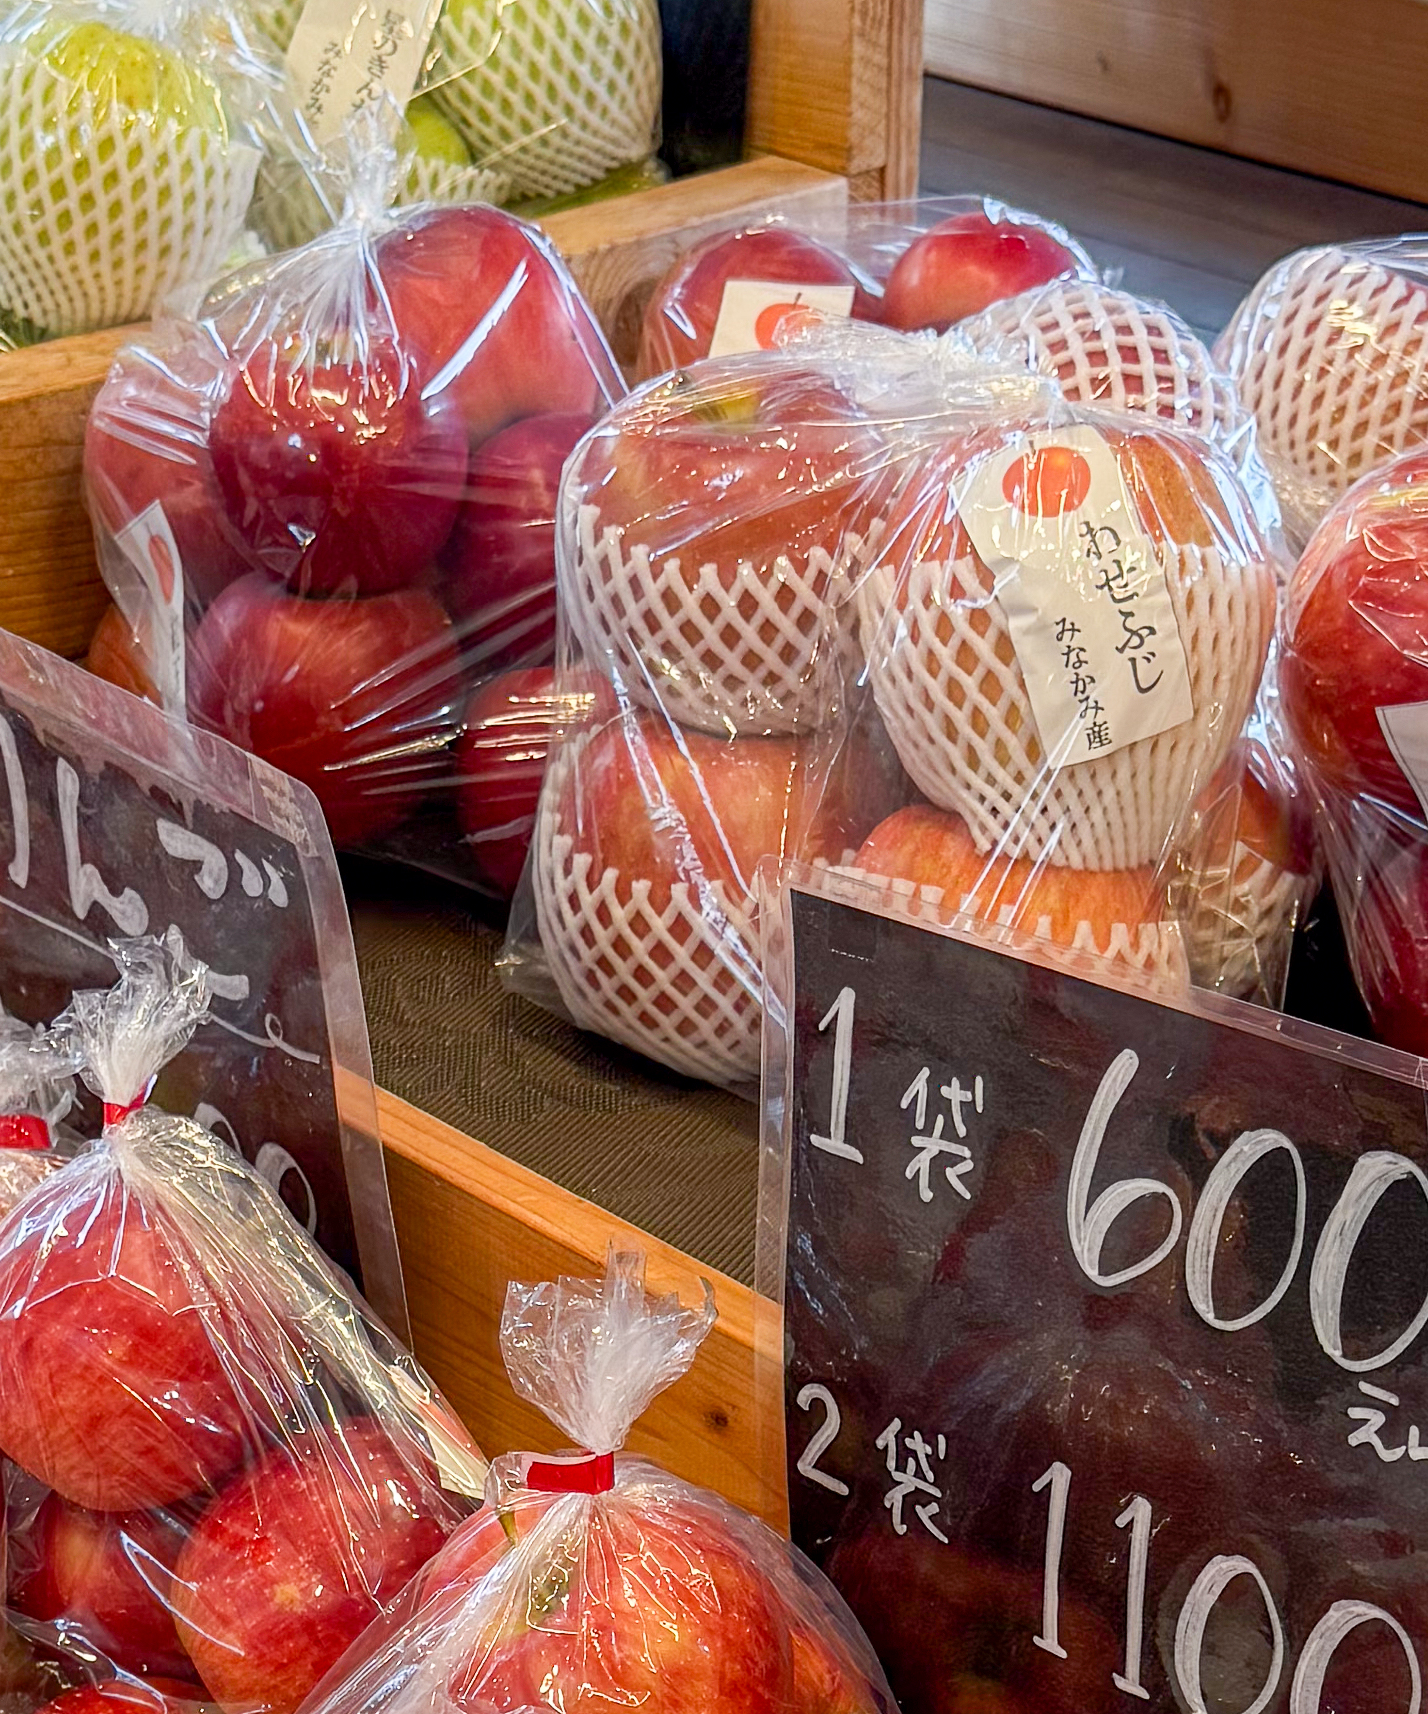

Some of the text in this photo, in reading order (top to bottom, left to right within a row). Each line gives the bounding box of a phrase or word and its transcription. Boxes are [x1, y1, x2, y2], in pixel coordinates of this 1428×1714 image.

[1054, 618, 1112, 750] みなかみ産
[1079, 520, 1164, 695] わせふじ
